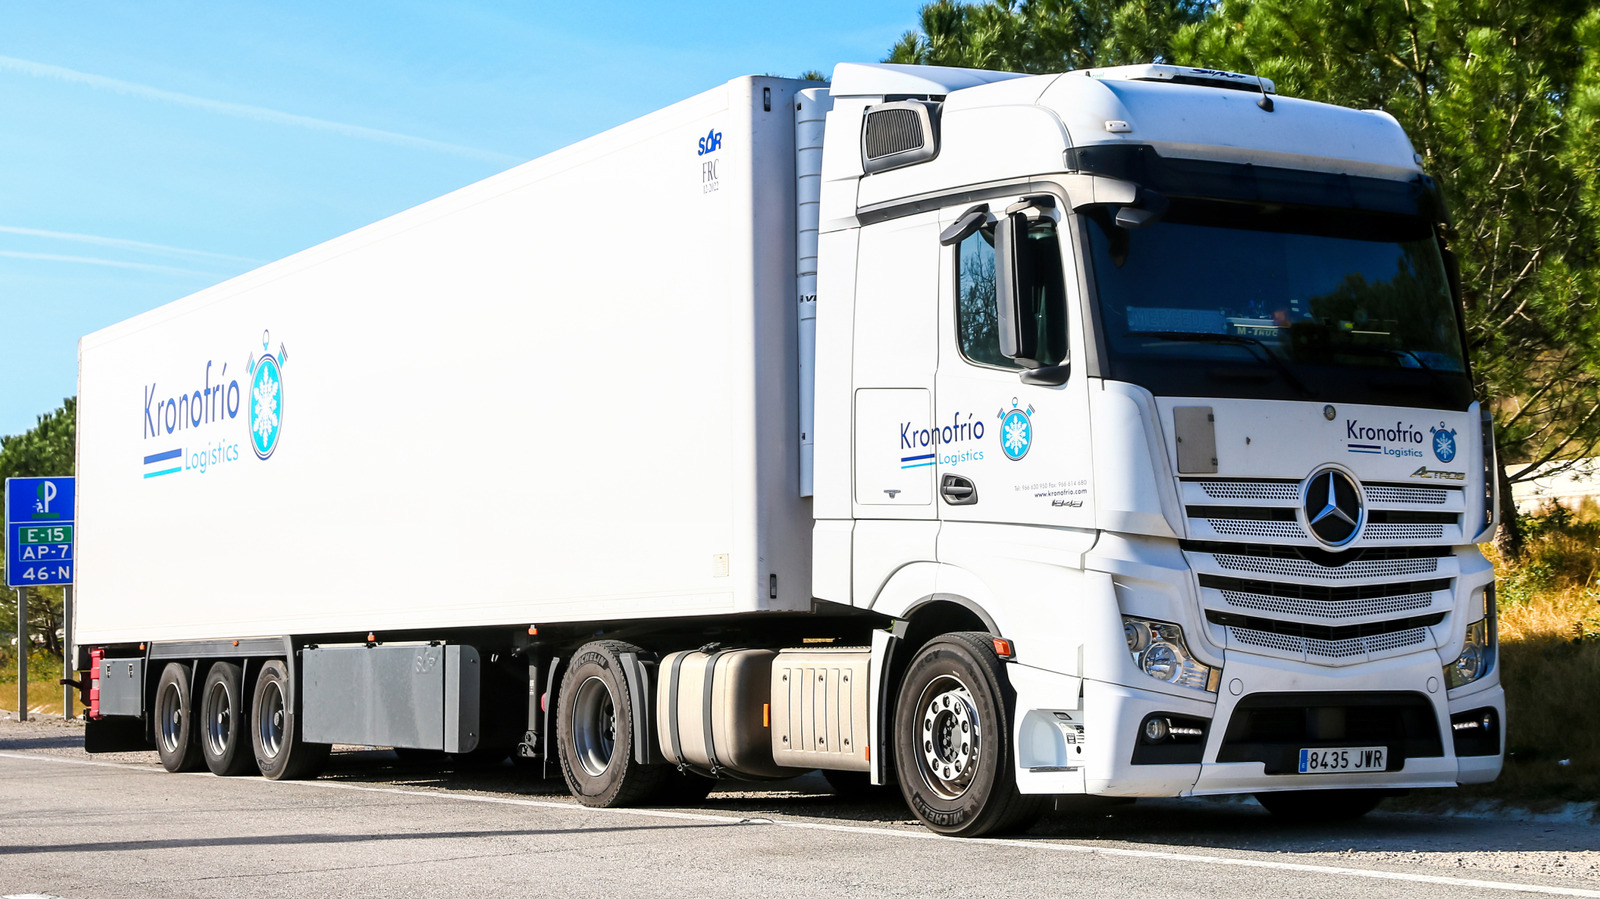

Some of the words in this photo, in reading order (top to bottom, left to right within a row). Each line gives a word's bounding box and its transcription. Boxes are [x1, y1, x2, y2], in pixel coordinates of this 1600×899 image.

[702, 158, 720, 183] FRC
[144, 360, 240, 439] Kronofrío
[900, 411, 985, 450] Kronofrío
[1346, 419, 1424, 444] Kronofrío
[185, 438, 239, 473] Logistics
[938, 448, 985, 466] Logistics
[1383, 446, 1424, 458] Logistics
[1034, 488, 1088, 498] www.kronofrio.com
[27, 527, 65, 542] E-15
[22, 545, 69, 560] AP-7
[22, 565, 70, 581] 46-N
[1310, 751, 1349, 769] 8435
[1354, 750, 1383, 768] JWR
[912, 796, 965, 826] MICHELIN
